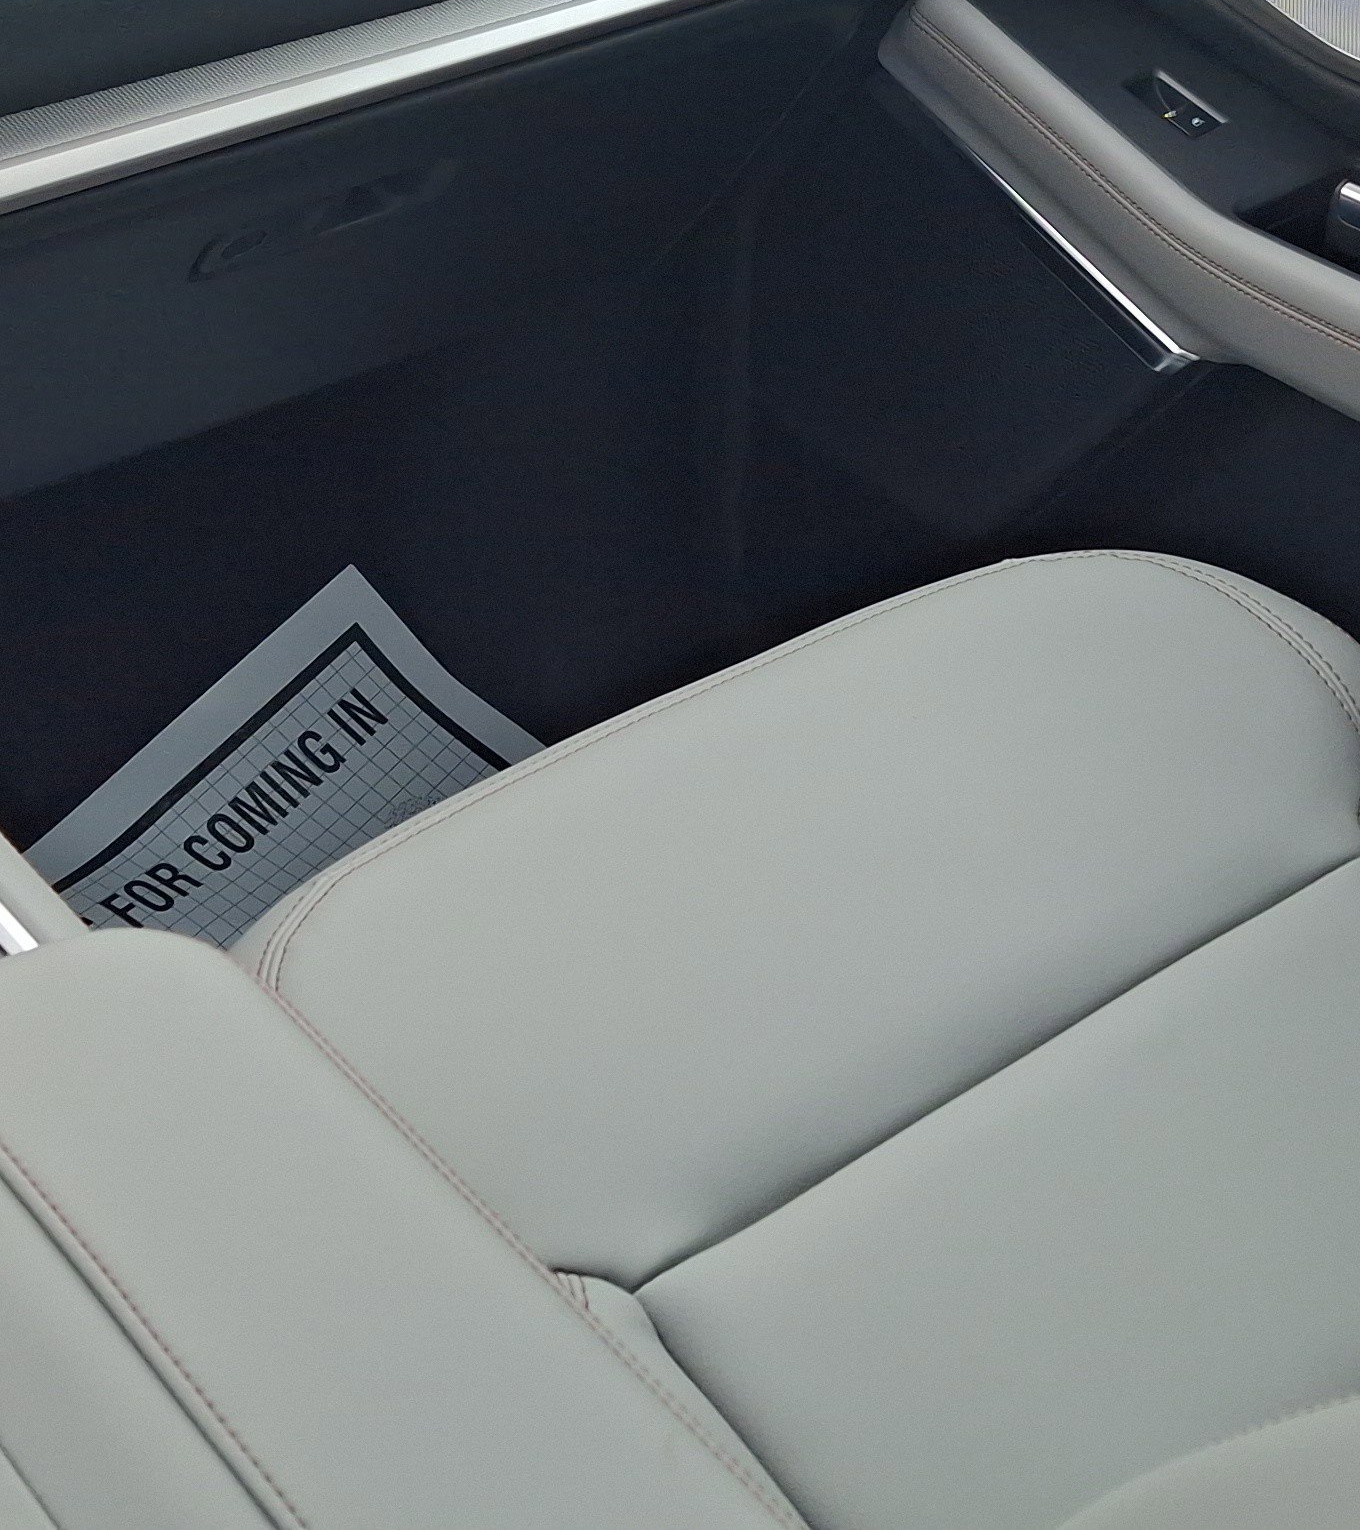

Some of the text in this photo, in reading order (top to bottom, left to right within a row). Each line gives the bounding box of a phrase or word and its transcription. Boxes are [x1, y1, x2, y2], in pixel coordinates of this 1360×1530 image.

[100, 687, 389, 928] FOR COMING IN
